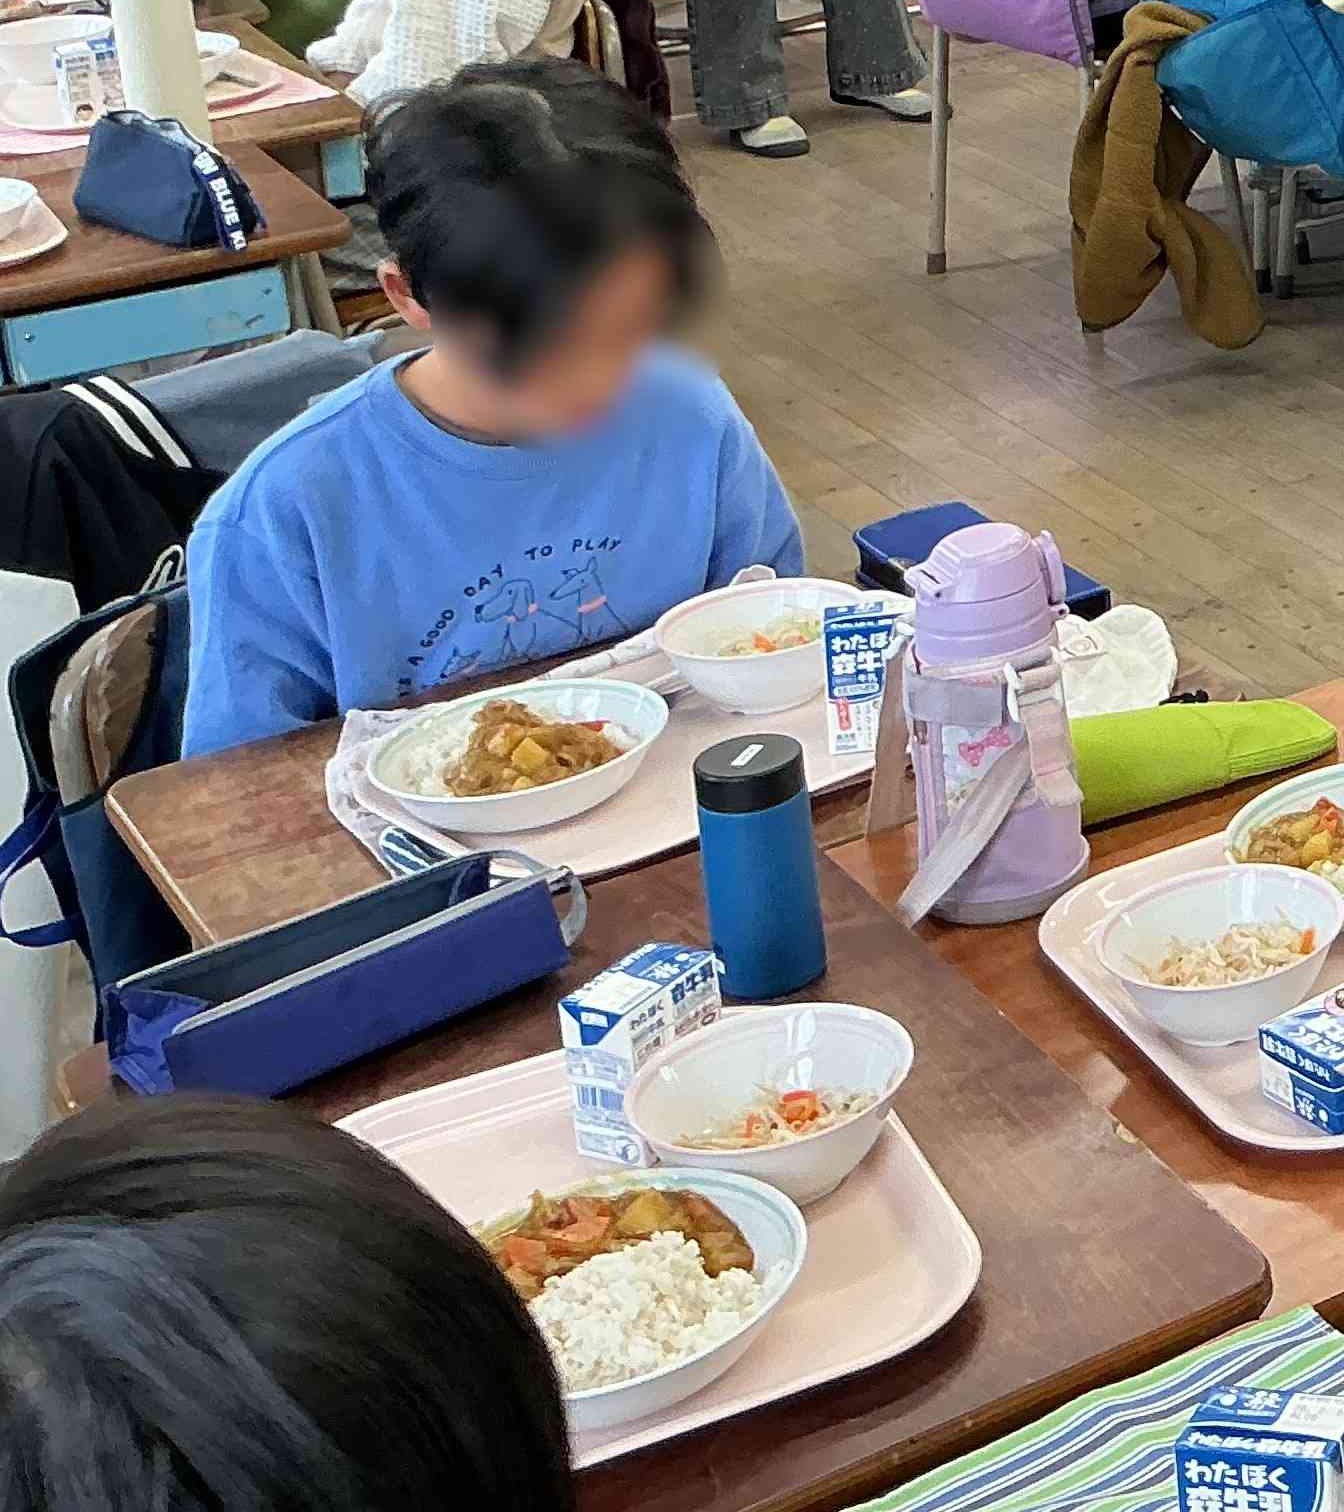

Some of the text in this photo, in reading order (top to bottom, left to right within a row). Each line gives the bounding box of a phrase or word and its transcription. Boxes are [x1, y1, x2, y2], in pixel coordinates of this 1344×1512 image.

[208, 177, 241, 226] BLUE
[408, 655, 423, 667] A
[524, 545, 553, 561] TO
[572, 537, 621, 553] PLAY
[832, 630, 889, 653] わたぼ
[1184, 1458, 1290, 1492] わたぼく
